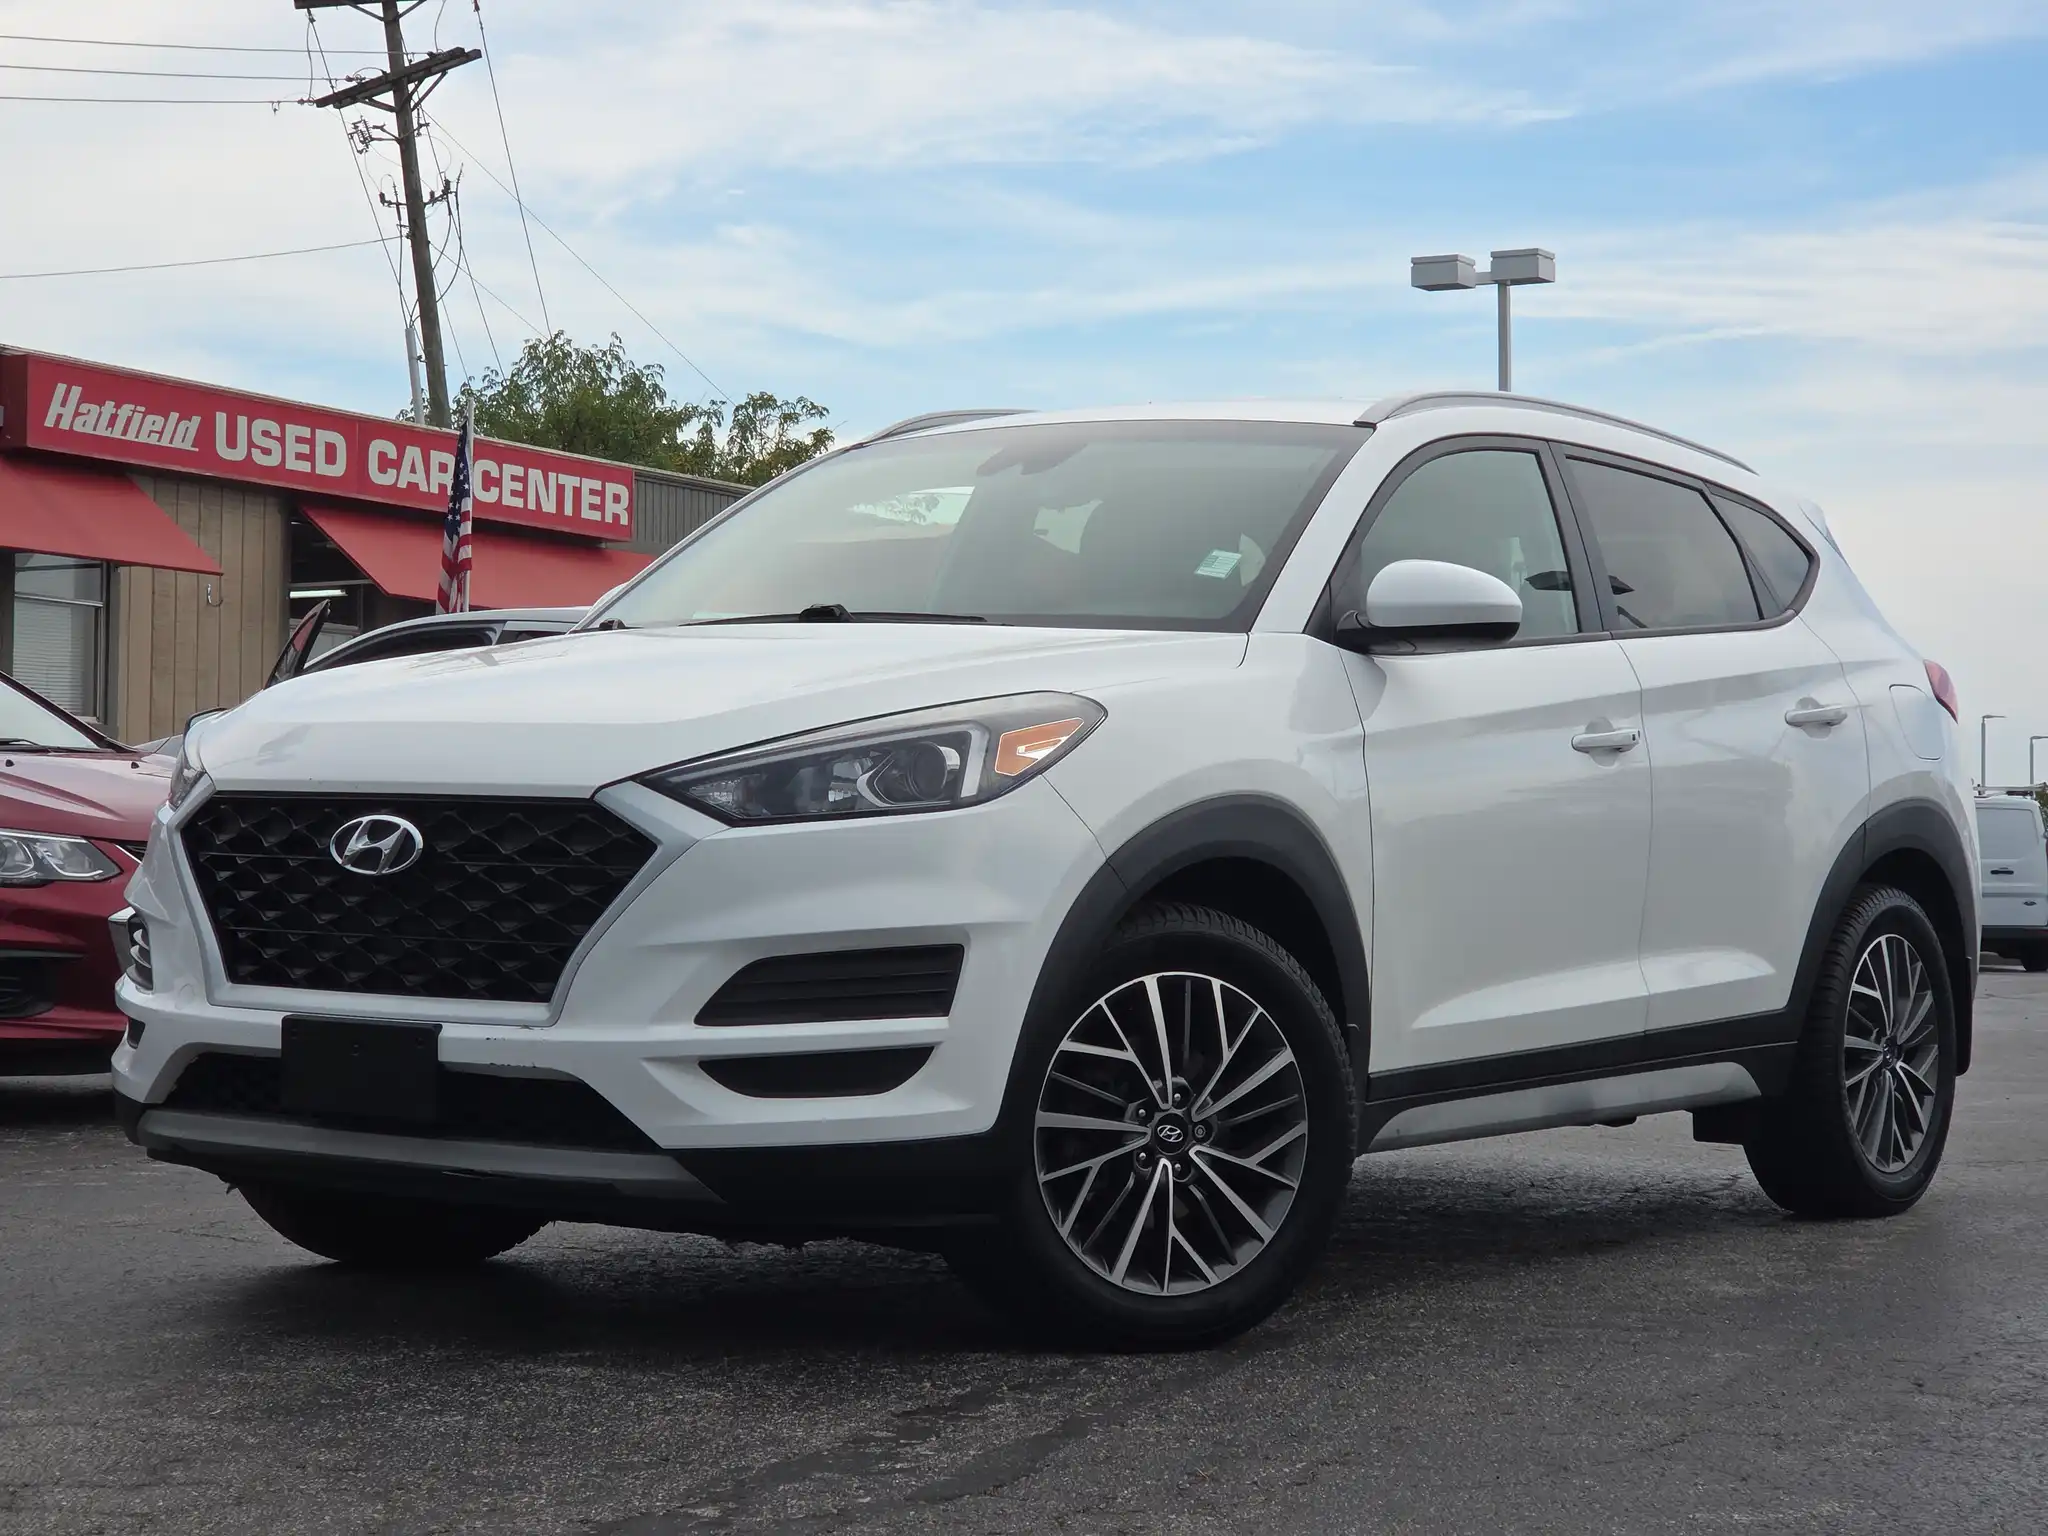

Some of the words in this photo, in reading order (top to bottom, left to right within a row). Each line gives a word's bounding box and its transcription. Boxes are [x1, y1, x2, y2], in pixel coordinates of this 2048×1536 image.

[44, 382, 201, 451] Hatfield
[215, 411, 347, 477] USED
[368, 438, 455, 496] CAR
[473, 458, 629, 526] CENTER
